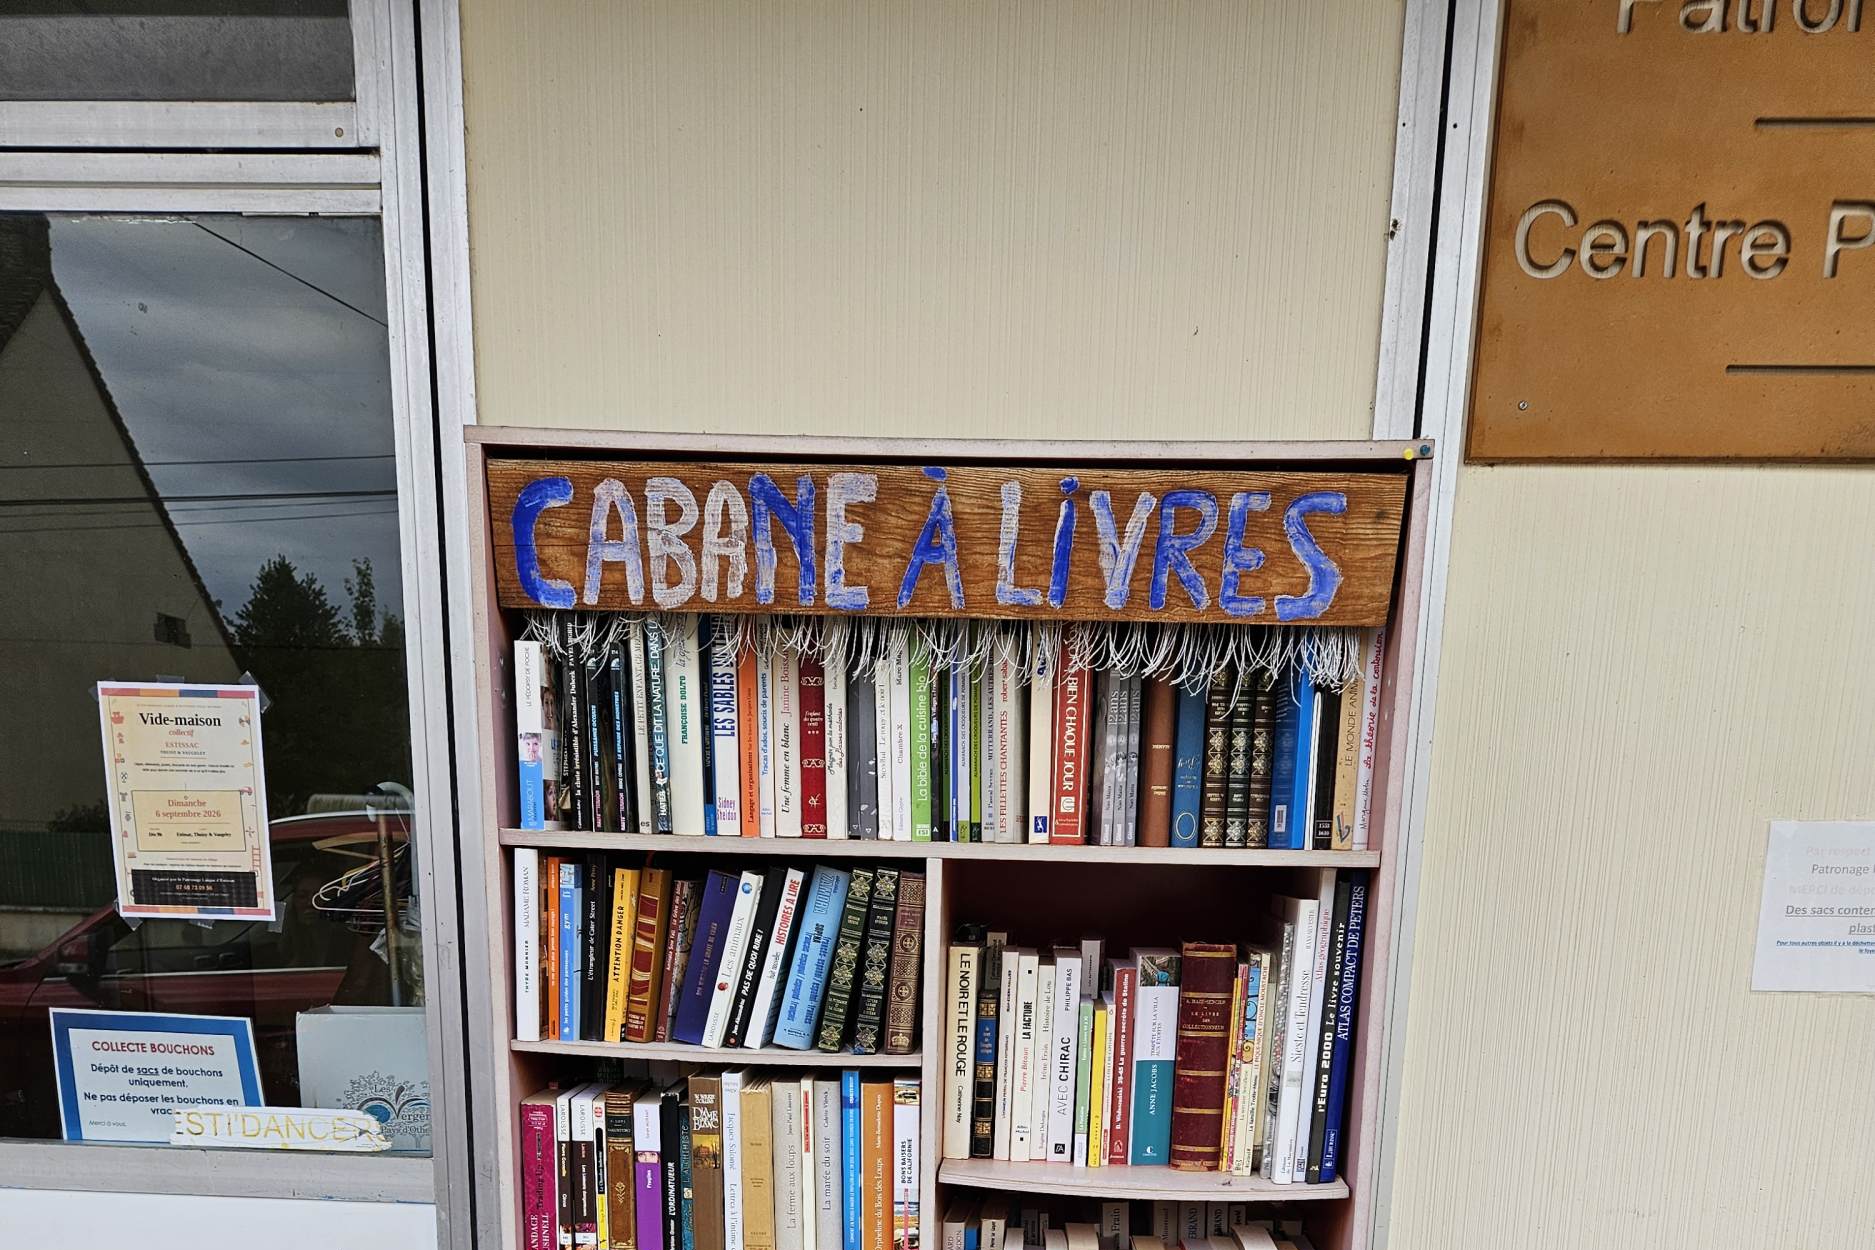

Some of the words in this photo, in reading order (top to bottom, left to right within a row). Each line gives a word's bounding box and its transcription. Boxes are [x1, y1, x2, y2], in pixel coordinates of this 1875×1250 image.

[1514, 198, 1792, 280] Centre
[511, 471, 879, 611] CABANE
[713, 673, 734, 713] SABLES
[915, 675, 926, 692] bio
[1067, 677, 1078, 704] BIEN
[140, 713, 221, 727] Vide-maison
[652, 704, 661, 717] LA
[916, 694, 927, 731] cuisine
[653, 719, 663, 732] DIT
[680, 703, 689, 744] FRANÇOISE
[714, 718, 735, 737] LES
[1064, 707, 1077, 756] CHAQUE
[1346, 711, 1356, 751] MONDE
[654, 736, 664, 756] QUE
[780, 723, 790, 749] blanc
[916, 733, 927, 743] la
[999, 710, 1008, 770] CHANTANTES
[783, 751, 790, 762] en
[916, 745, 927, 759] de
[1344, 756, 1353, 767] LE
[655, 759, 664, 771] CE
[916, 761, 927, 785] bible
[1063, 760, 1074, 790] JOUR
[776, 764, 792, 795] femme
[168, 799, 207, 807] Dimanche
[658, 791, 667, 816] HATIER
[781, 795, 790, 813] Une
[917, 787, 928, 801] La
[999, 772, 1007, 817] FILLETTES
[161, 810, 201, 819] septembre
[999, 818, 1007, 833] LES
[522, 866, 530, 895] ROMAN
[1812, 864, 1869, 876] Patronage
[775, 904, 794, 945] HISTOIRES
[788, 879, 800, 897] LIRE
[1349, 887, 1365, 929] PETERS
[1786, 905, 1807, 915] Des
[1810, 906, 1834, 915] sacs
[616, 906, 624, 934] DANGER
[751, 934, 762, 950] RIRE
[1332, 922, 1345, 976] souvenir
[1347, 933, 1361, 947] DE
[612, 939, 622, 982] ATTENTION
[747, 951, 757, 970] QUOI
[960, 953, 971, 968] LE
[744, 970, 753, 982] DE
[959, 970, 970, 999] NOIR
[1341, 949, 1359, 1003] COMPACT
[740, 982, 750, 996] PAS
[1064, 983, 1072, 1011] PHILIPPE
[1328, 982, 1340, 1008] livre
[958, 1001, 969, 1016] ET
[1022, 1001, 1033, 1027] FACTURE
[1323, 1013, 1335, 1025] Le
[958, 1019, 968, 1033] LE
[1337, 1006, 1352, 1040] ATLAS
[1022, 1029, 1032, 1039] LA
[92, 1041, 147, 1053] COLLECTE
[151, 1043, 215, 1056] BOUCHONS
[956, 1035, 967, 1076] ROUGE
[1058, 1036, 1070, 1082] CHIRAC
[1321, 1032, 1333, 1069] 2000
[91, 1063, 119, 1073] Dépôt
[137, 1067, 159, 1075] sacs
[176, 1068, 223, 1077] bouchons
[1149, 1064, 1159, 1092] JACOBS
[84, 1092, 97, 1101] Ne
[100, 1094, 117, 1103] pas
[119, 1093, 159, 1104] déposer
[161, 1095, 175, 1104] les
[177, 1095, 224, 1105] bouchons
[374, 1085, 391, 1093] Les
[1317, 1074, 1329, 1112] l'Euro
[1057, 1086, 1068, 1115] AVEC
[1149, 1094, 1157, 1115] ANNE
[907, 1176, 912, 1184] DE
